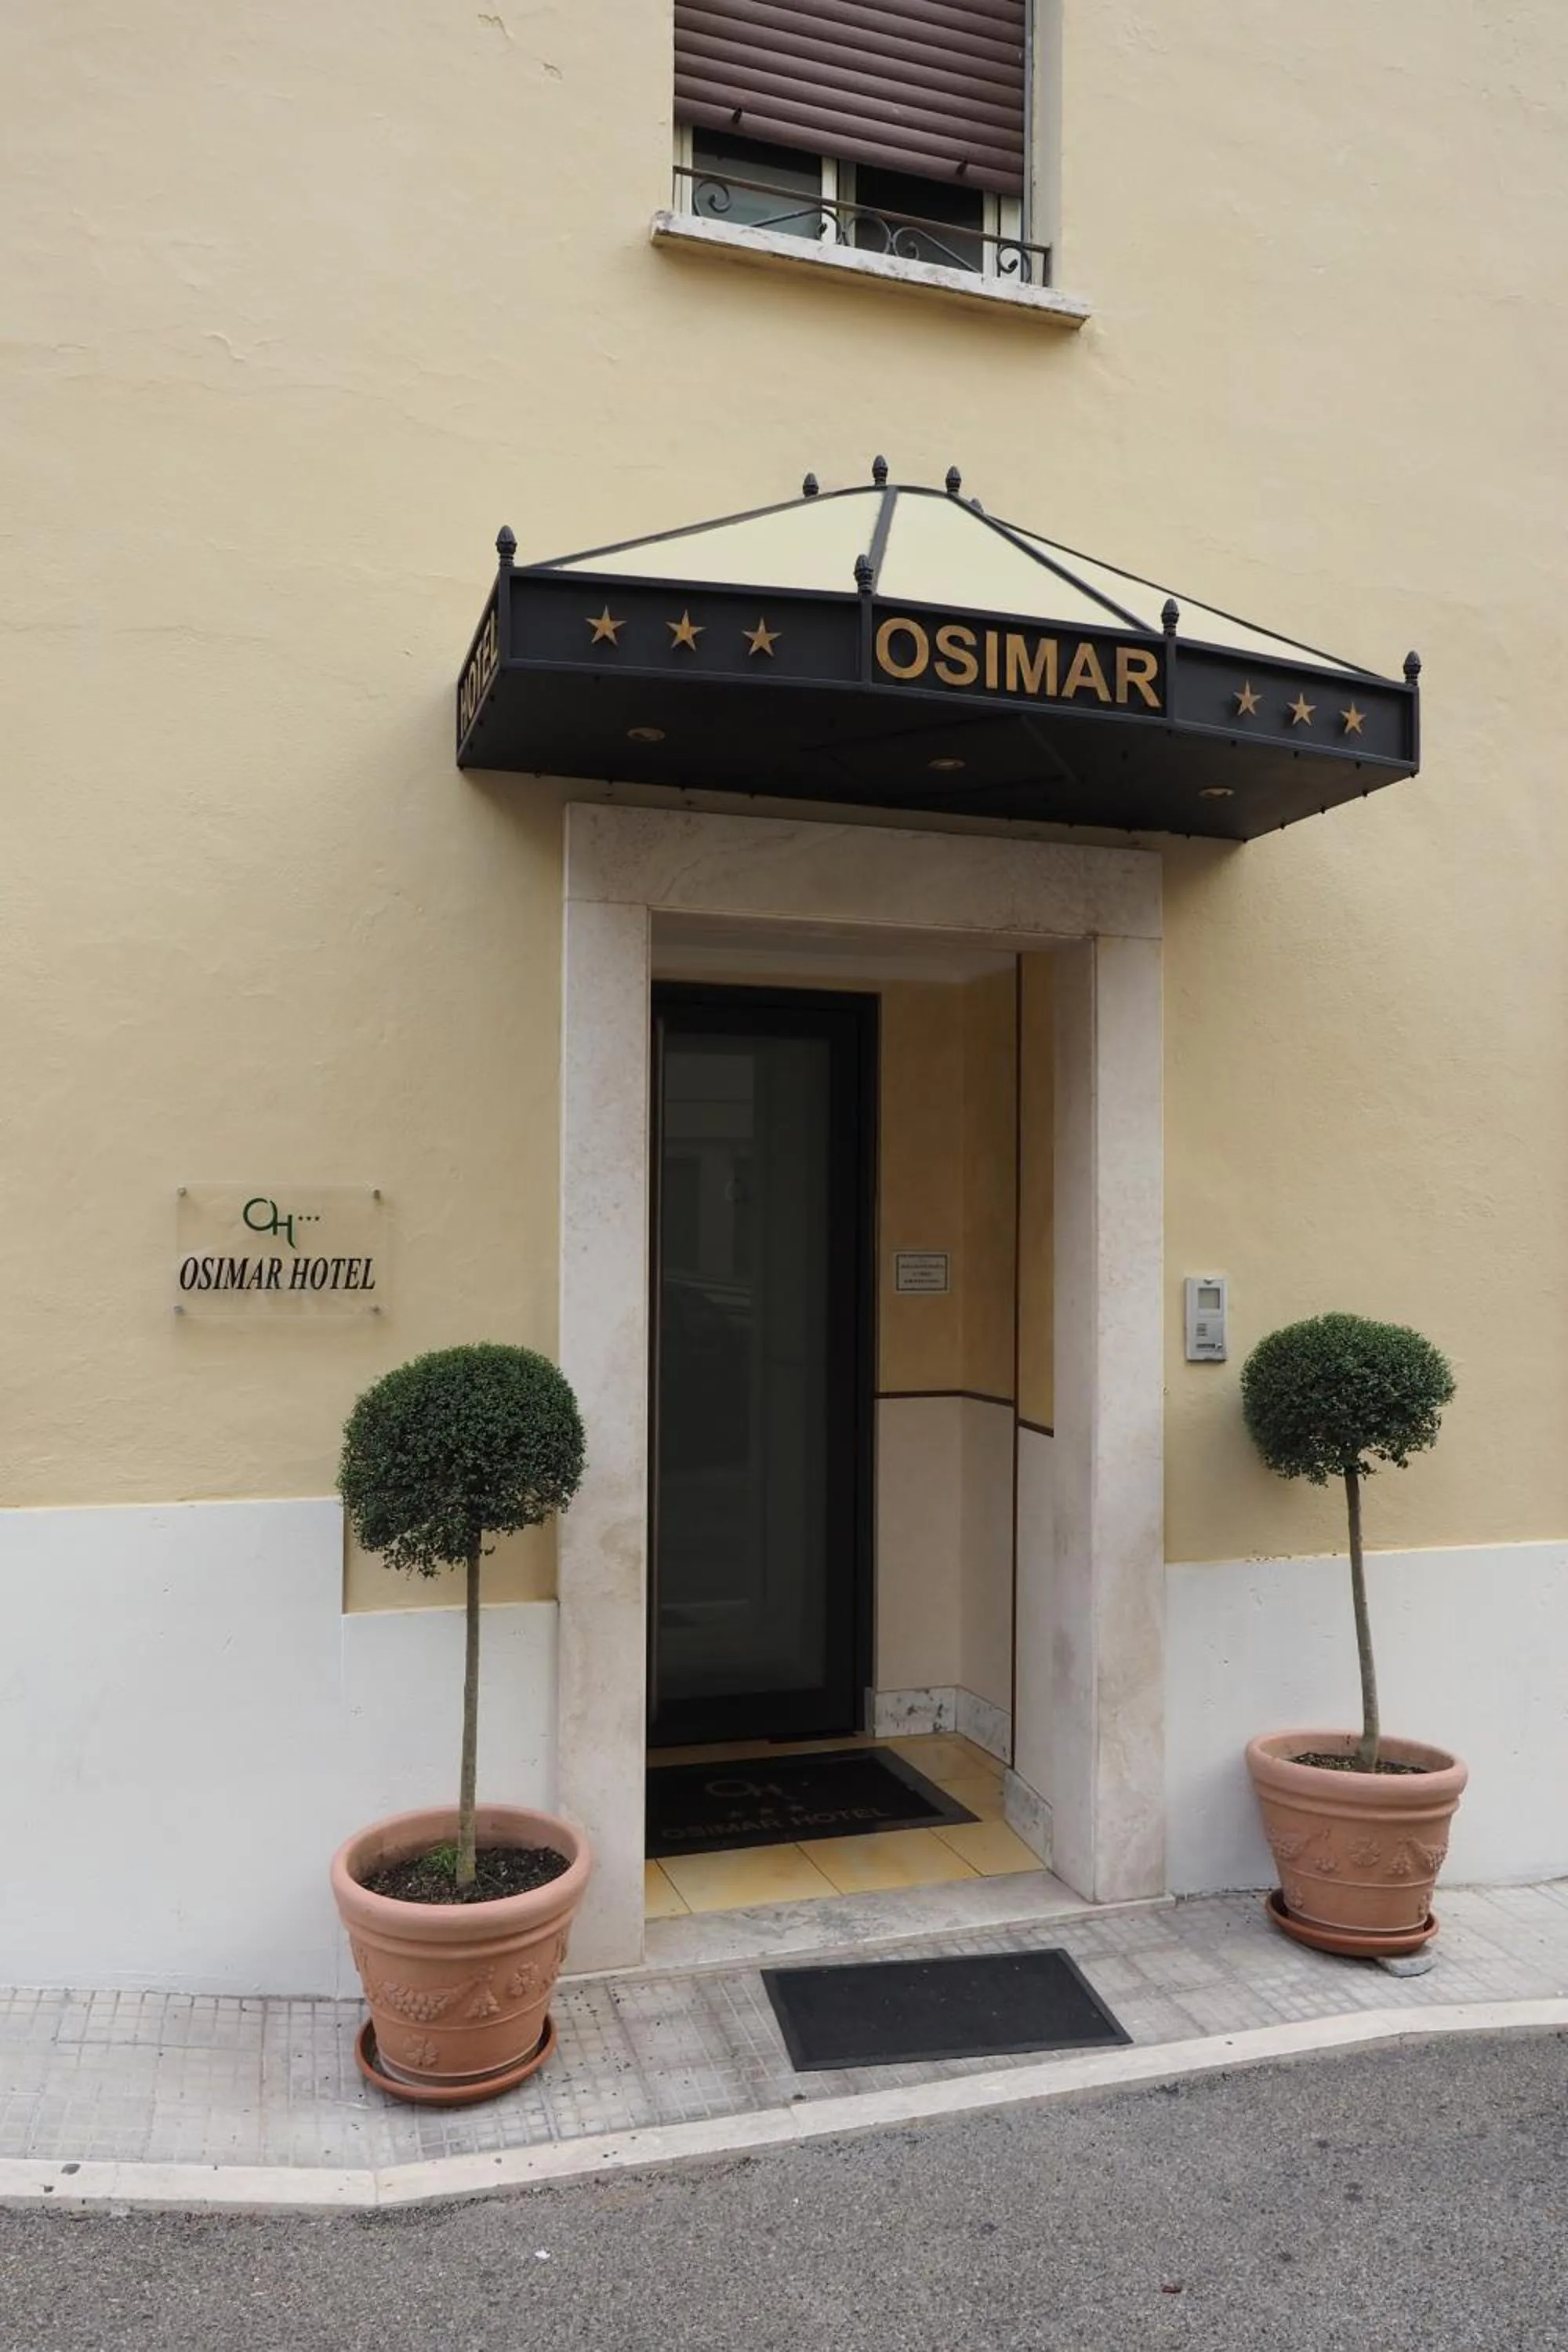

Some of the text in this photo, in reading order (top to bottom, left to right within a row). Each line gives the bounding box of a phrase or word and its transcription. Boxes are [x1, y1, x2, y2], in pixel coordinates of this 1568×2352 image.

[460, 608, 498, 740] HOTEL
[876, 617, 1162, 710] OSIMAR
[180, 1257, 376, 1290] OSIMAR HOTEL
[661, 1806, 891, 1839] OSIMAR HOTEL
